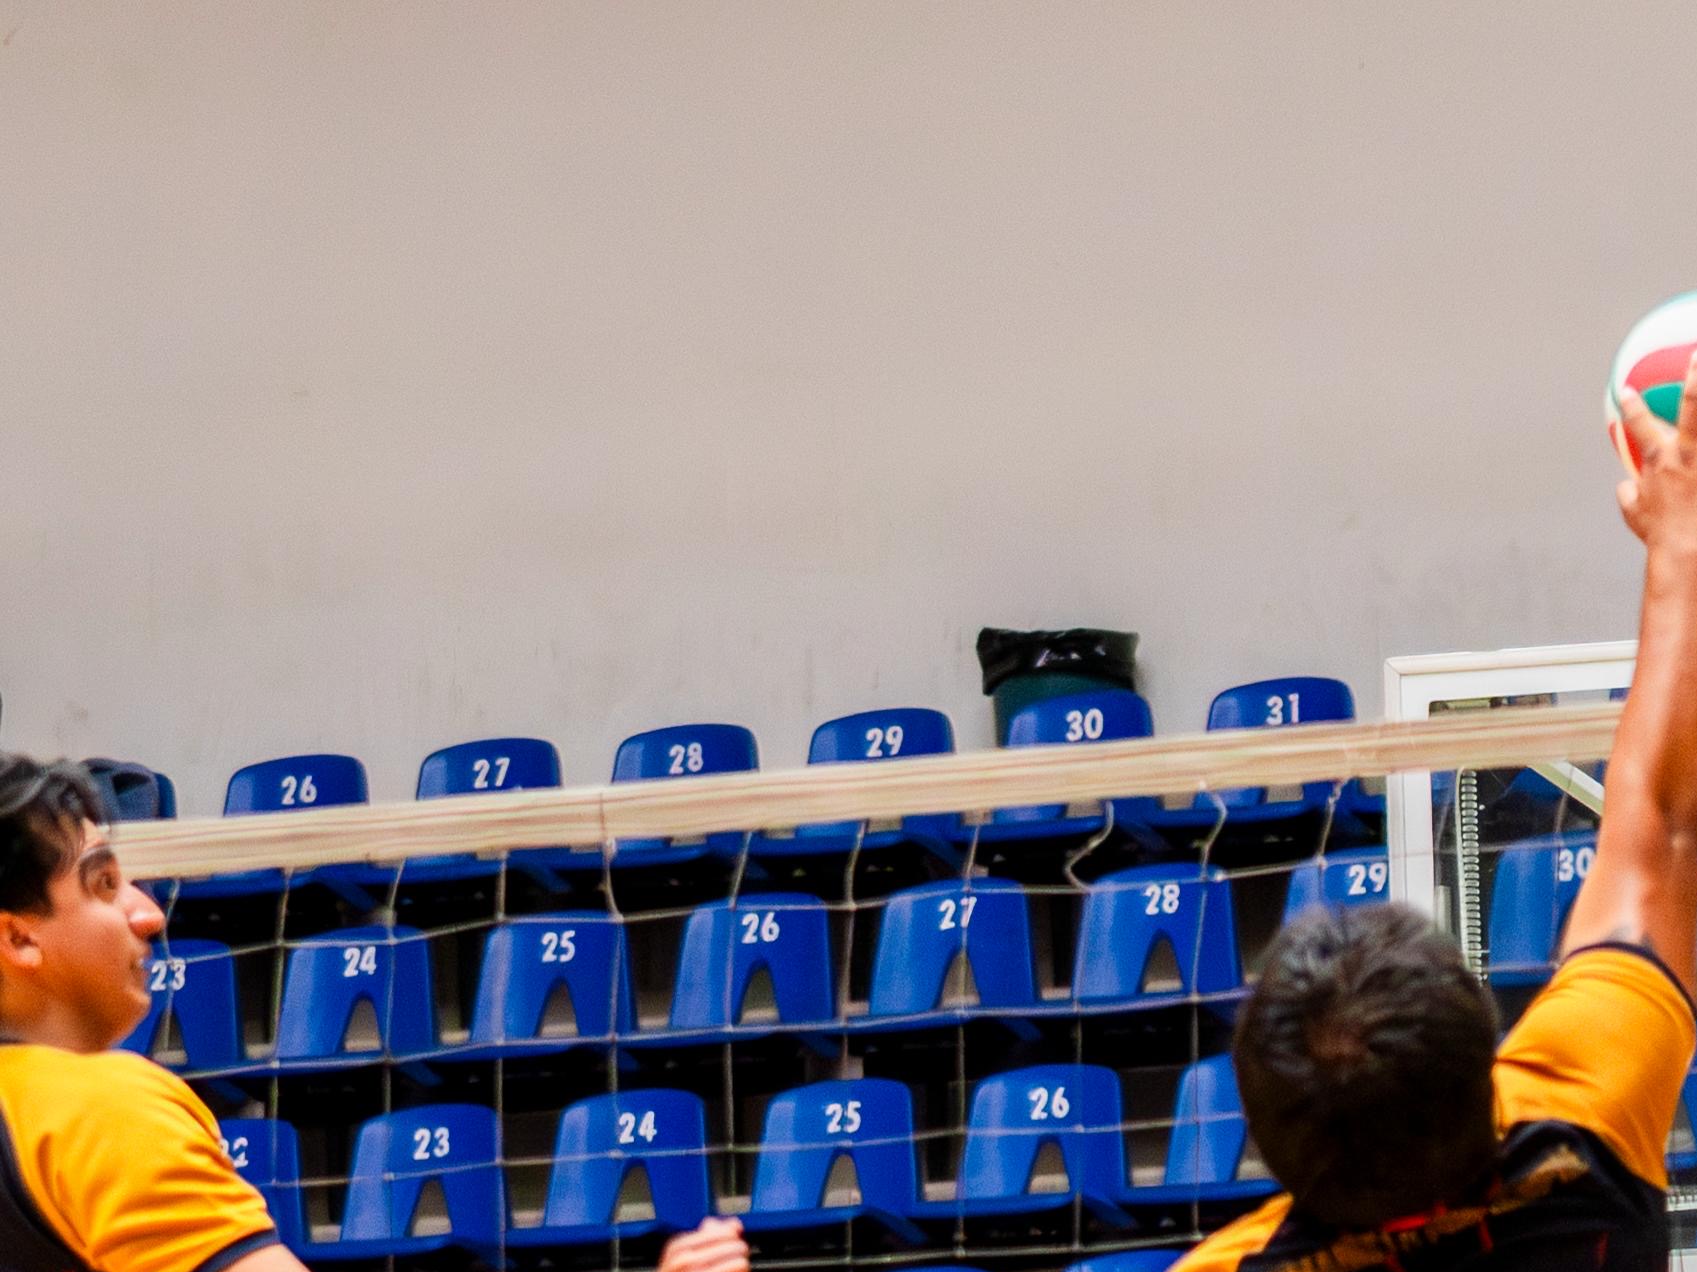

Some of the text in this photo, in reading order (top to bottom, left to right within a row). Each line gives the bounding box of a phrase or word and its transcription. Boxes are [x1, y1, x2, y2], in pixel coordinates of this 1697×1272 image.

[1065, 708, 1103, 742] 30
[1266, 692, 1299, 725] 31
[669, 743, 703, 774] 28
[866, 726, 903, 758] 29
[473, 757, 511, 789] 27
[281, 775, 317, 805] 26
[1348, 863, 1388, 896] 29
[1558, 848, 1596, 882] 30
[938, 896, 976, 930] 27
[1144, 883, 1180, 915] 28
[741, 912, 780, 945] 26
[343, 946, 377, 978] 24
[541, 931, 575, 963] 25
[150, 958, 186, 991] 23
[825, 1101, 862, 1134] 25
[1029, 1086, 1070, 1120] 26
[413, 1127, 450, 1160] 23
[618, 1110, 657, 1144] 24
